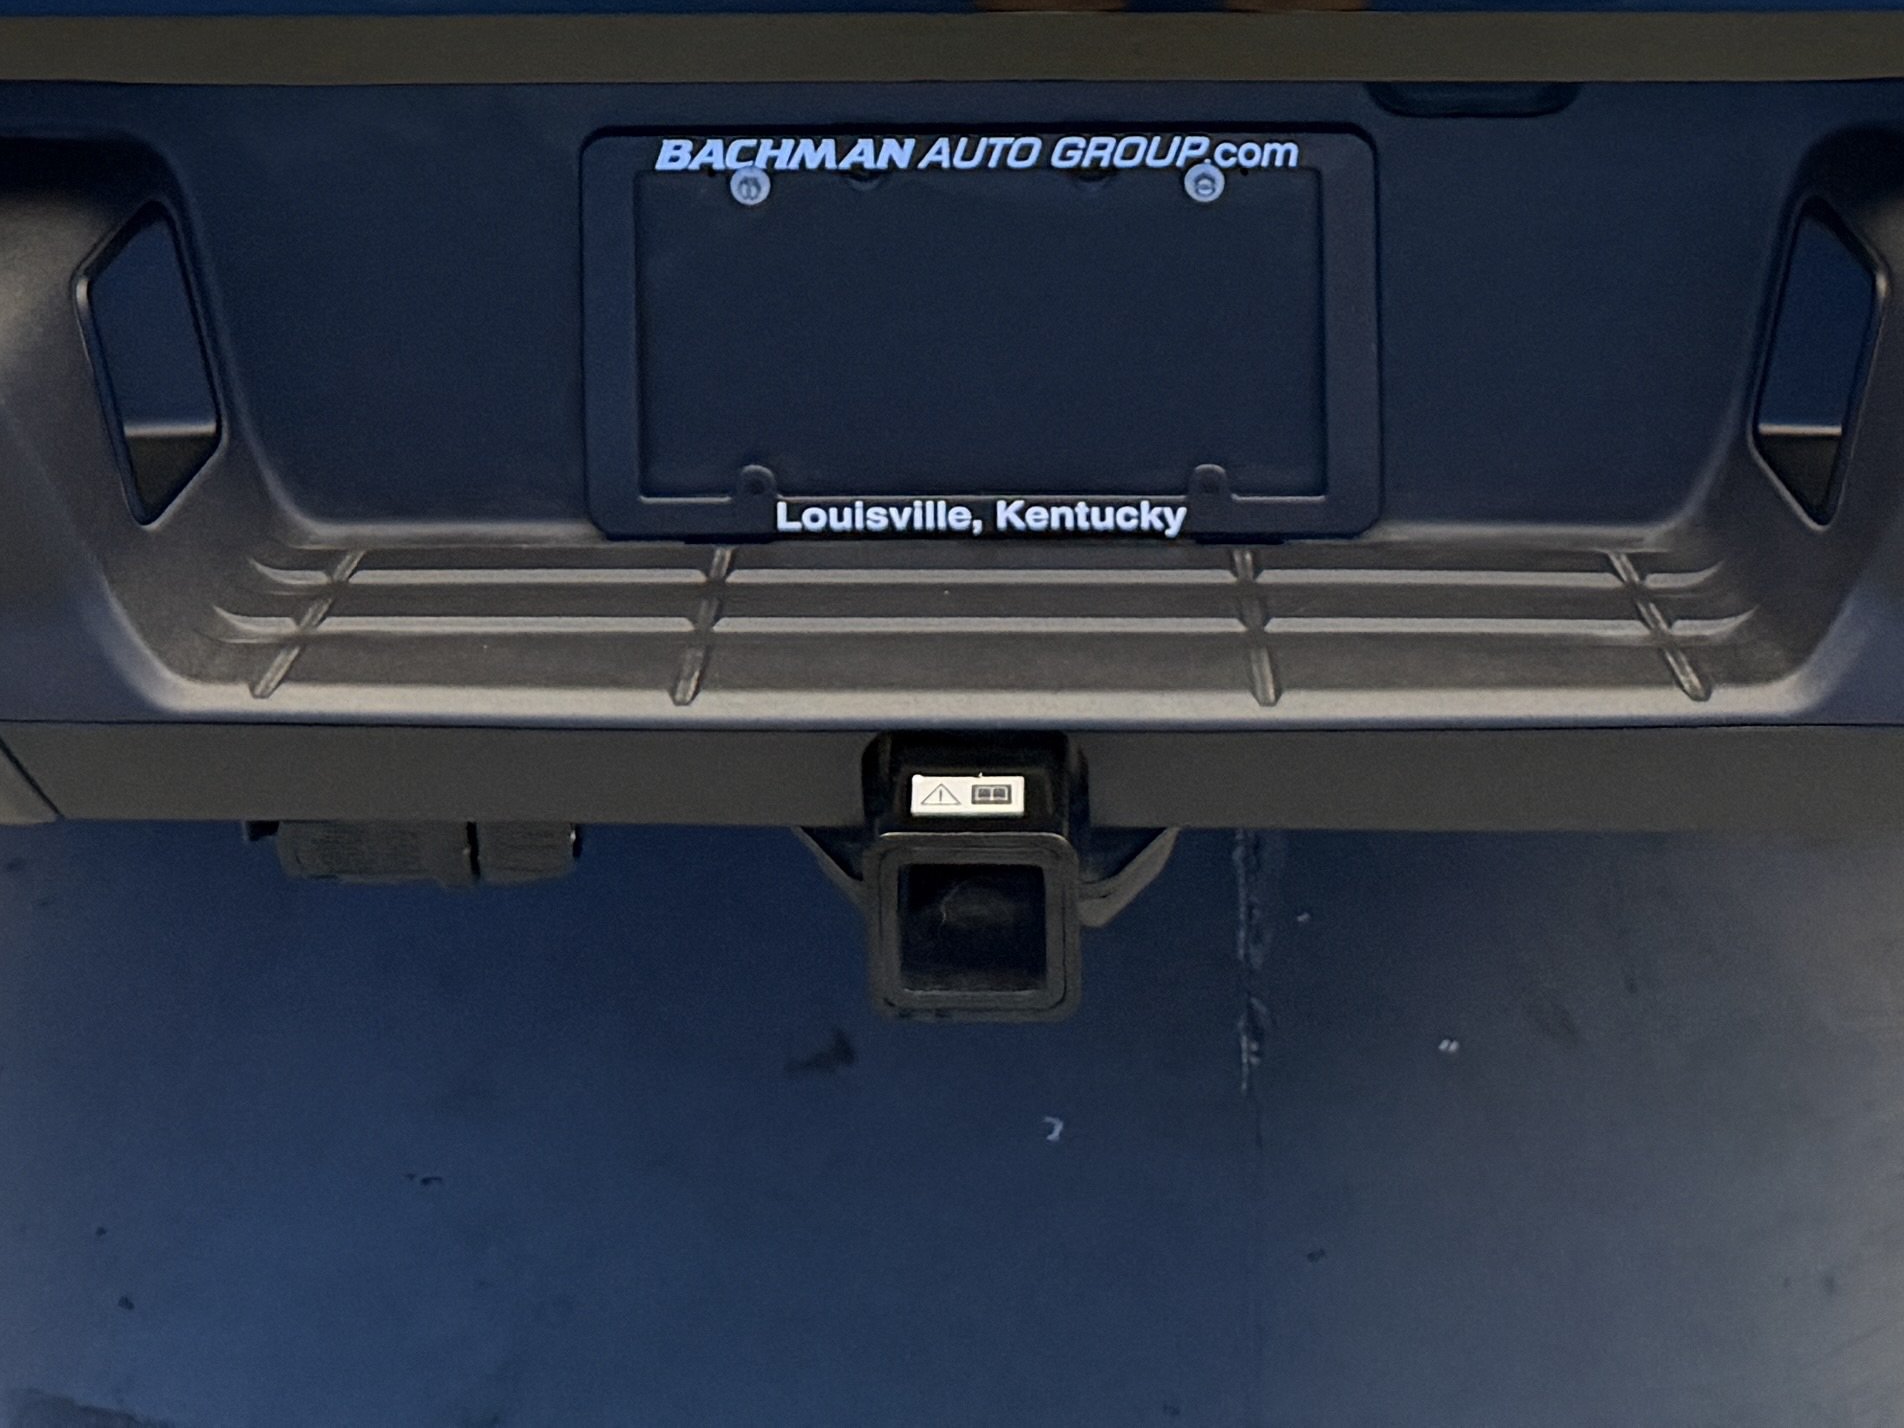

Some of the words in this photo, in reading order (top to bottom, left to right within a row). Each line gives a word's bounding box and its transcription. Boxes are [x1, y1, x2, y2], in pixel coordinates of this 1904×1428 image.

[655, 138, 916, 171] BACHMAN
[918, 137, 1038, 169] AUTO
[1050, 135, 1299, 169] GROUP.com
[775, 500, 984, 536] Louisville,
[996, 500, 1188, 538] Kentucky
